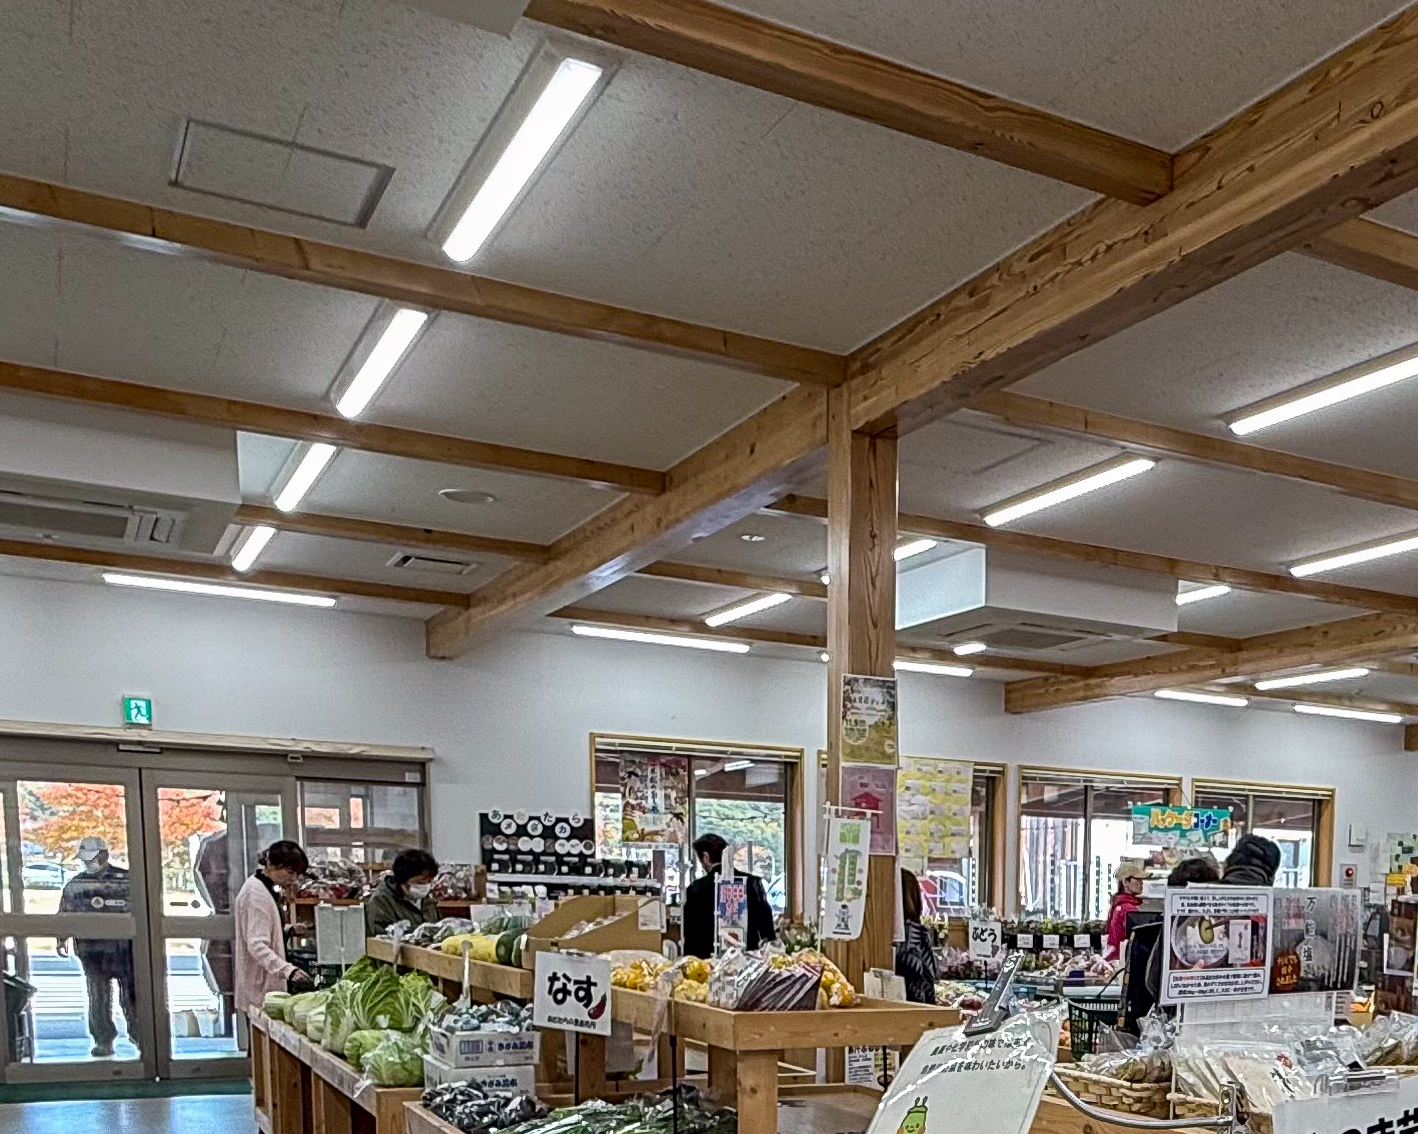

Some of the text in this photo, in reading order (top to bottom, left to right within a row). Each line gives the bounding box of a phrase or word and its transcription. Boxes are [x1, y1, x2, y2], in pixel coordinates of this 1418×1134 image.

[971, 926, 998, 943] ぶどう
[547, 971, 598, 1009] なす
